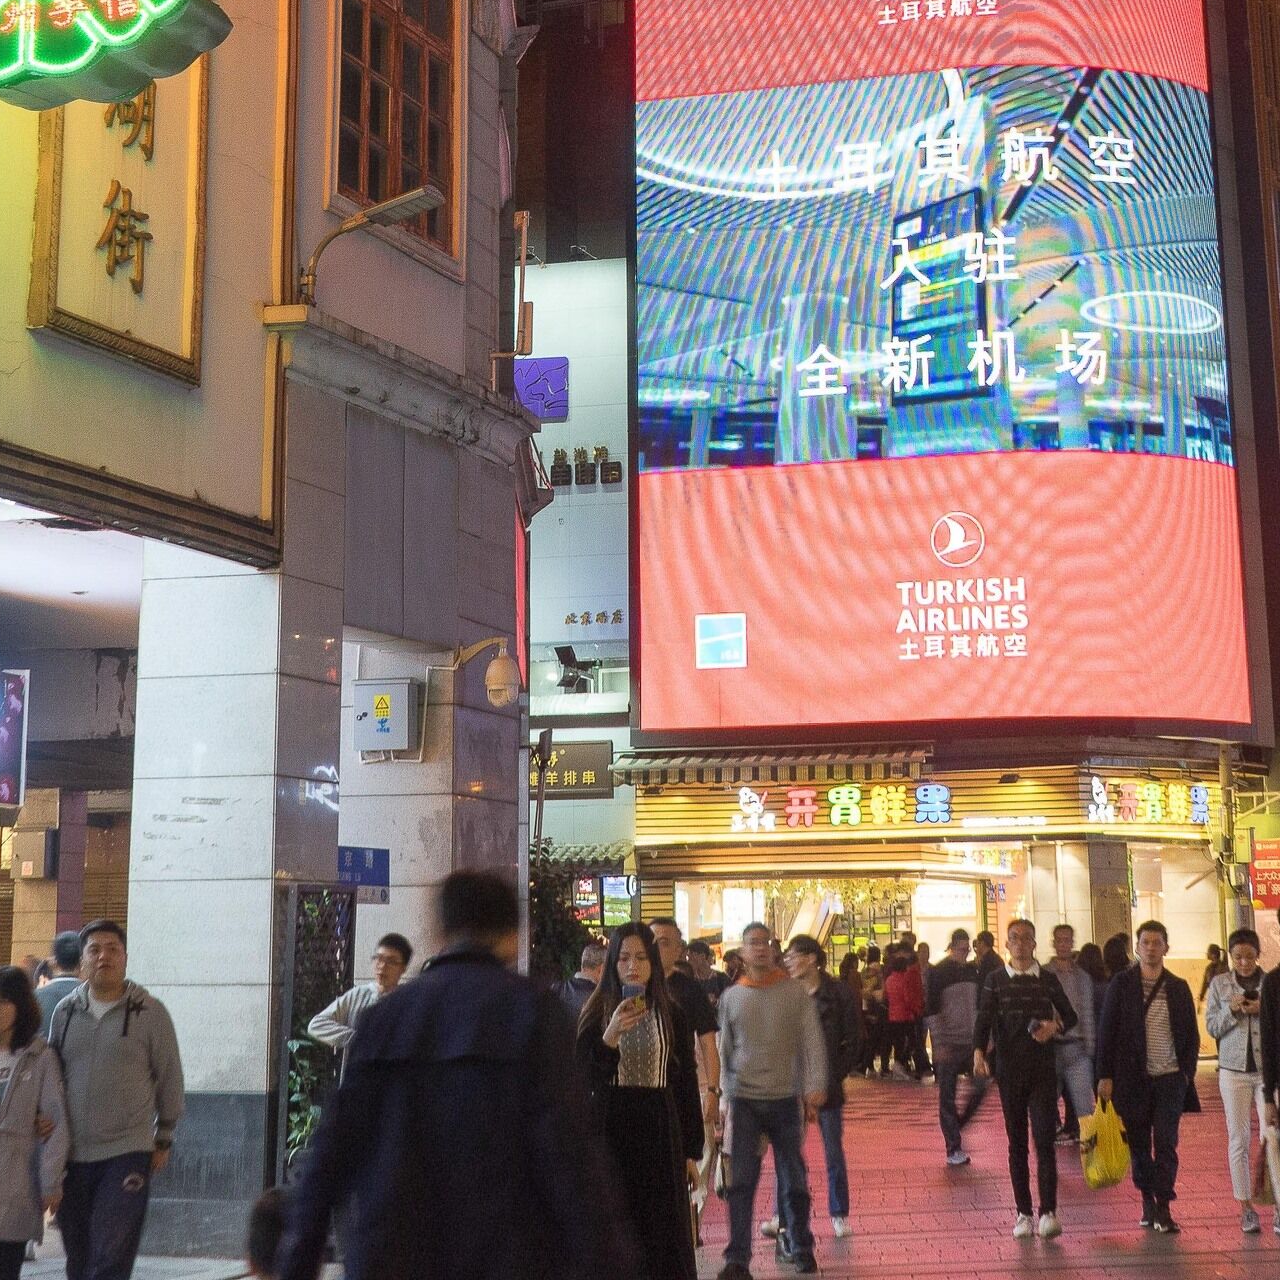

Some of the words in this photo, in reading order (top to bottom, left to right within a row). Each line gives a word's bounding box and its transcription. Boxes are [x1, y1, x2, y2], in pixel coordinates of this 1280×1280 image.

[880, 231, 1022, 290] 入驻
[797, 326, 1109, 398] 全新机场
[896, 577, 1026, 605] TURKISH
[896, 604, 1029, 634] AIRLINES
[898, 633, 1028, 660] 土耳其航空
